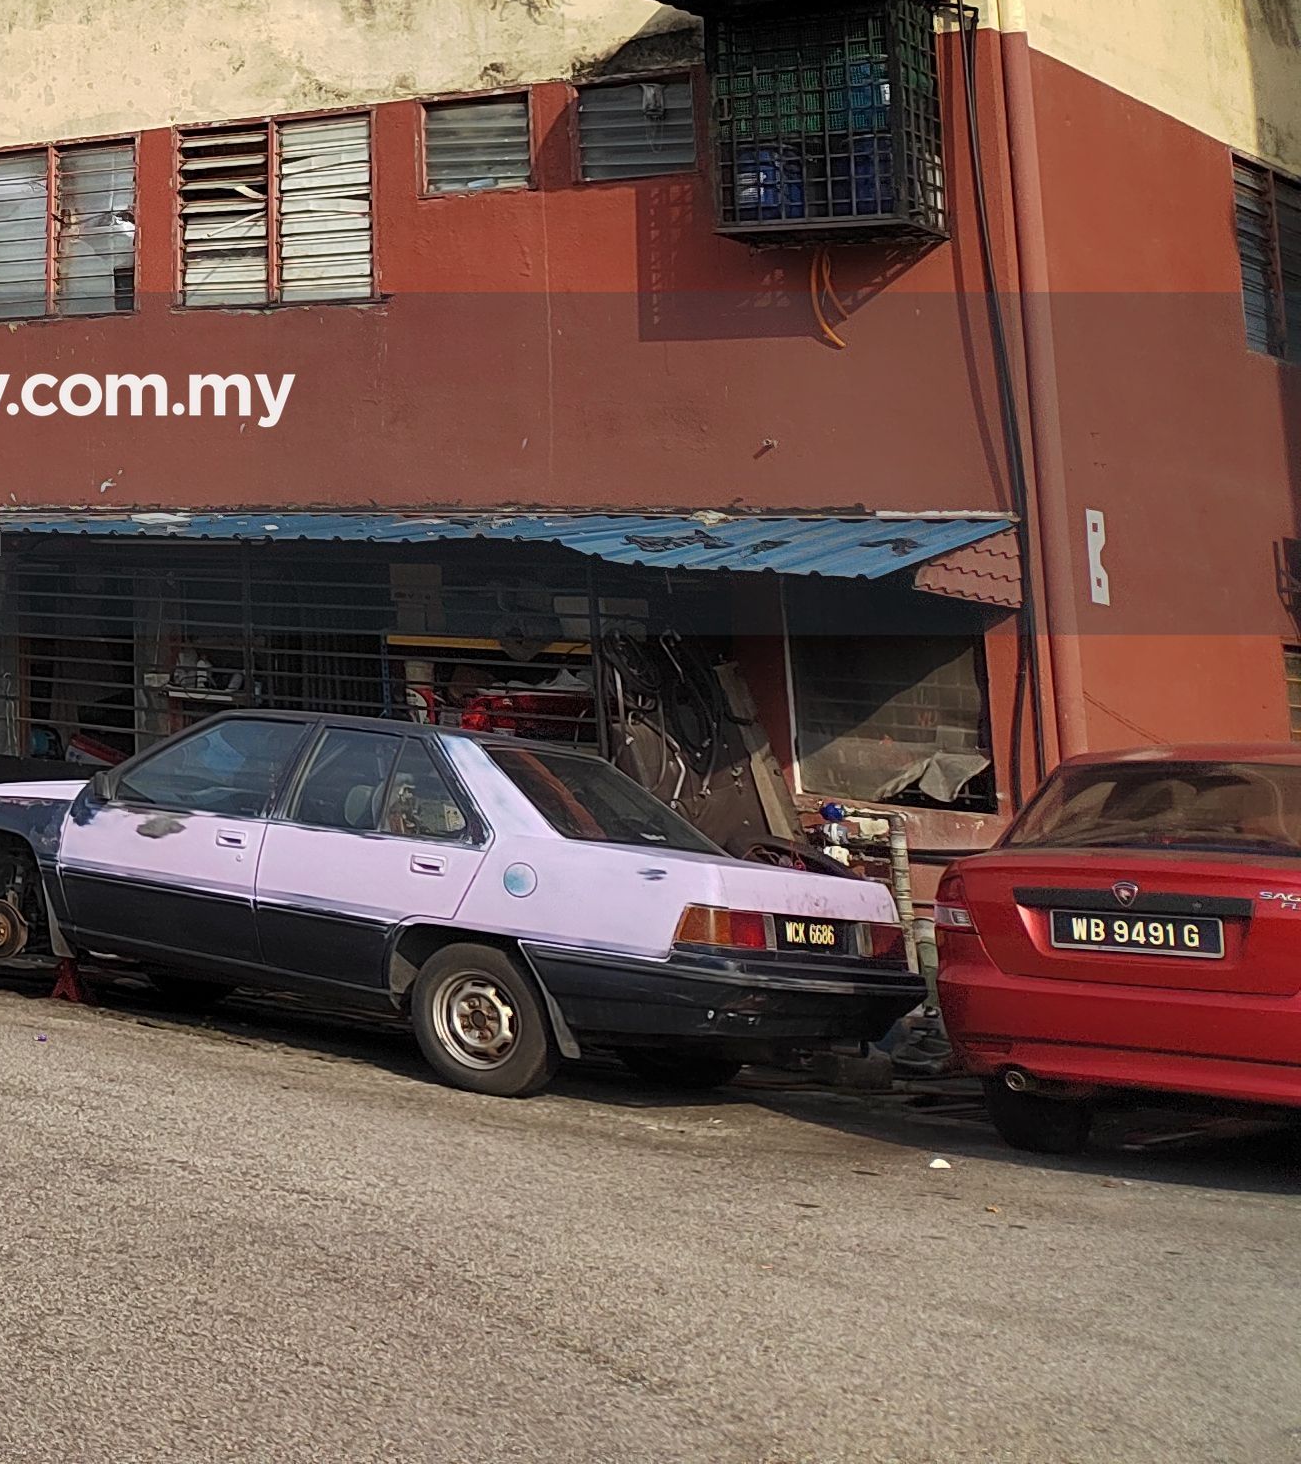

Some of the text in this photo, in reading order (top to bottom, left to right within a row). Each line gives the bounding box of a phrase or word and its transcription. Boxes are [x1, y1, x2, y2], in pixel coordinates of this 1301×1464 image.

[1071, 916, 1200, 948] WB 9491 G
